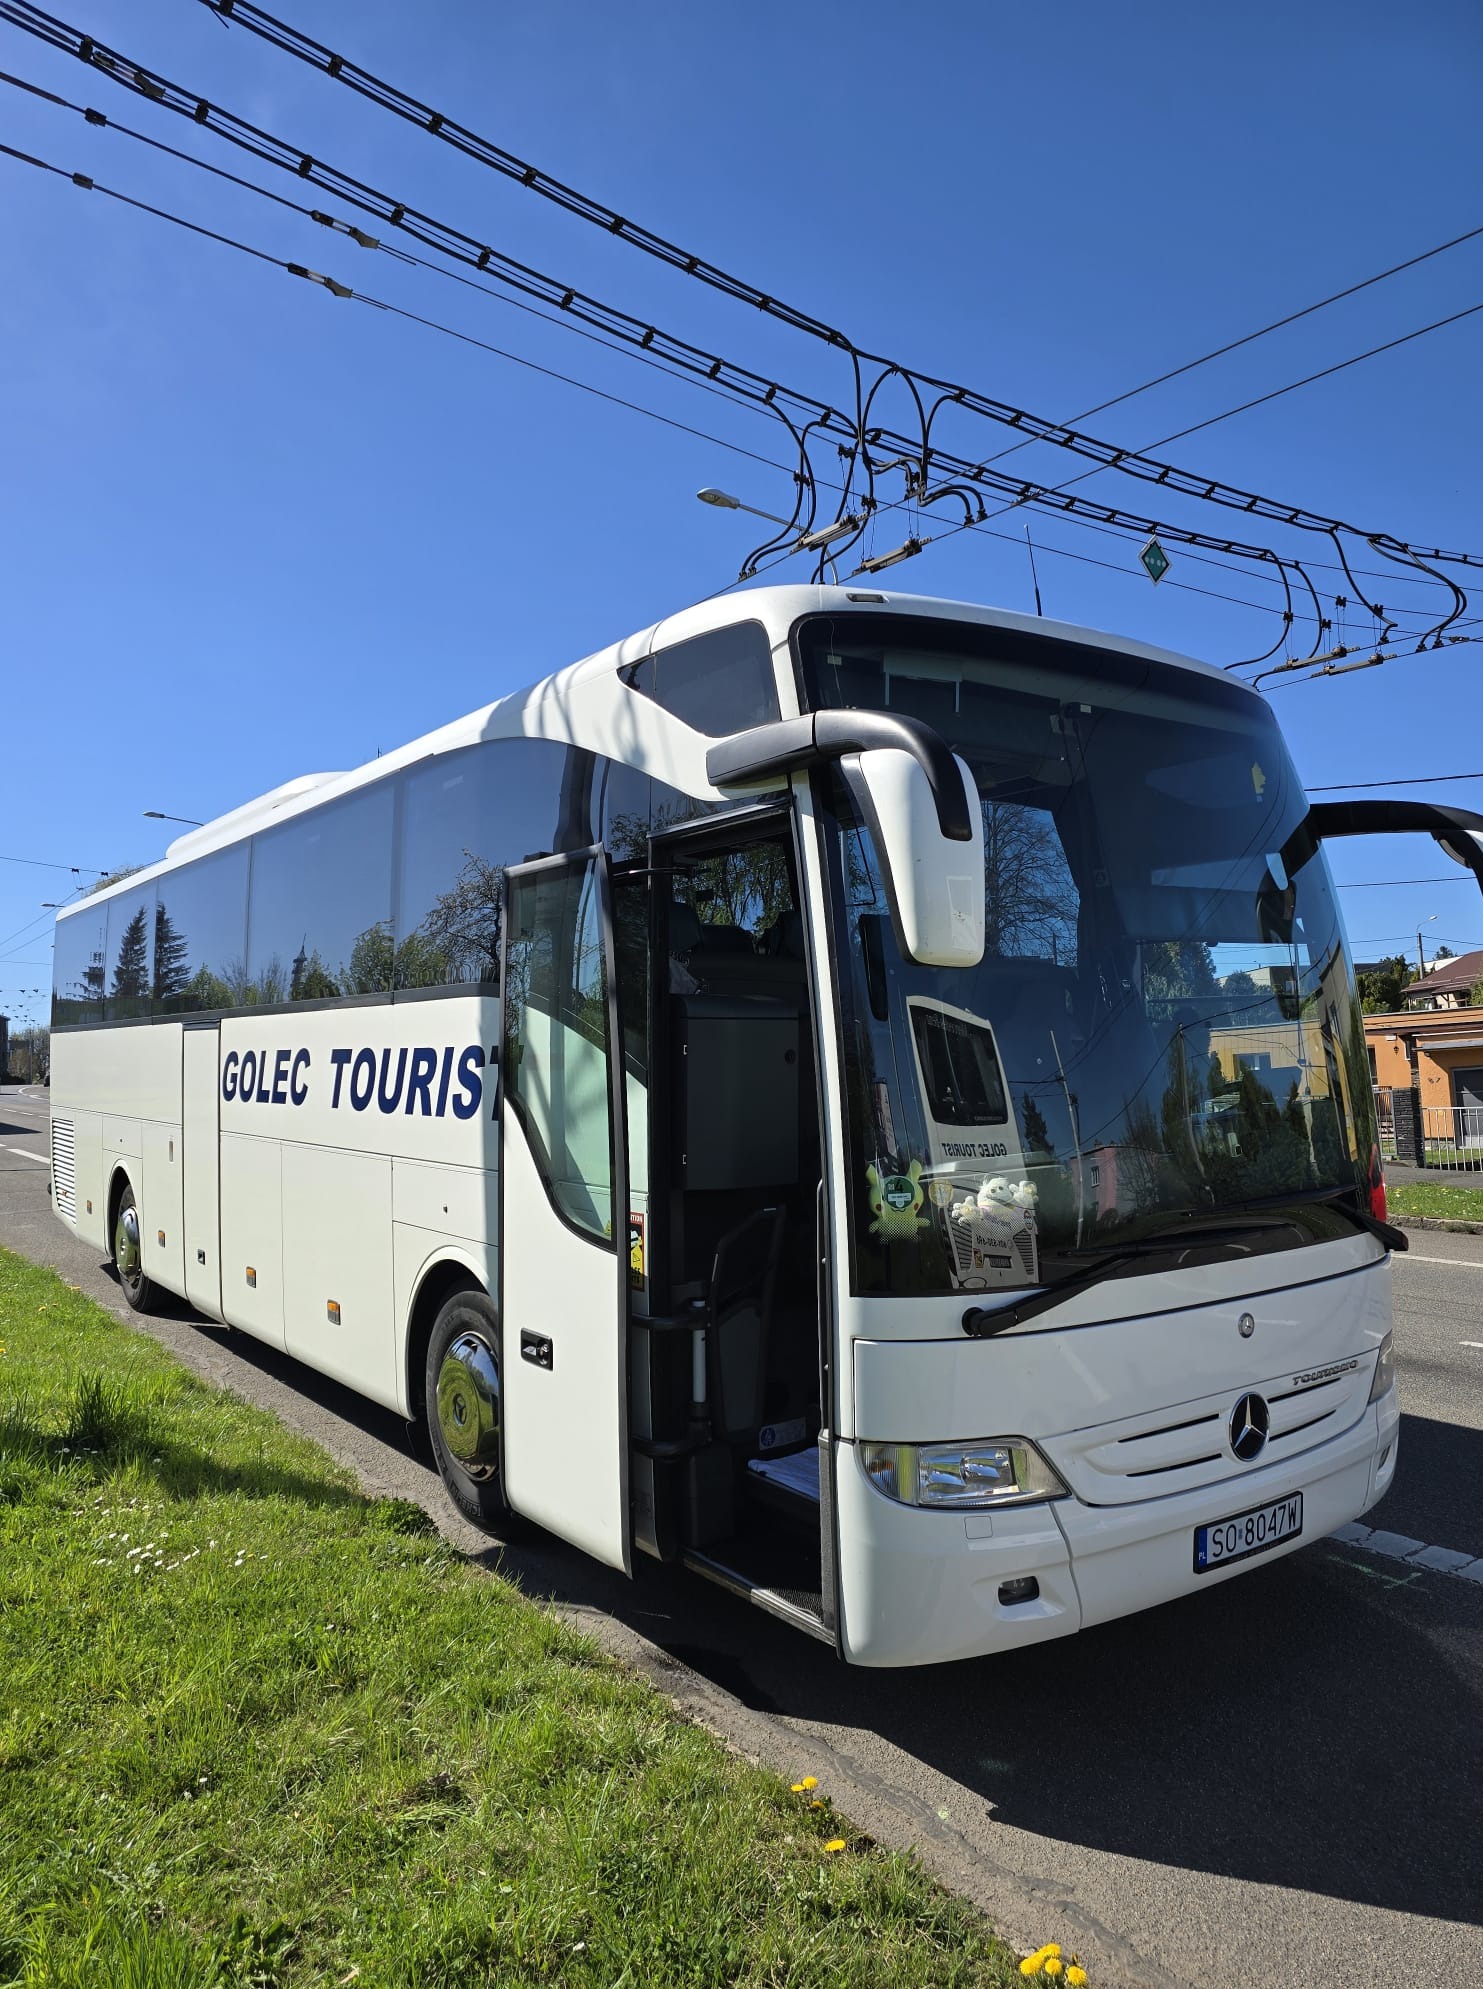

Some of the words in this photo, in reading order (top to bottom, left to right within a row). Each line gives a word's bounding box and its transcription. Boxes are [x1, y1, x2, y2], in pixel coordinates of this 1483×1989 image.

[222, 1048, 311, 1106] GOLEC
[1198, 1551, 1207, 1561] PL
[1212, 1524, 1237, 1557] SO
[1245, 1500, 1297, 1546] 8047W
